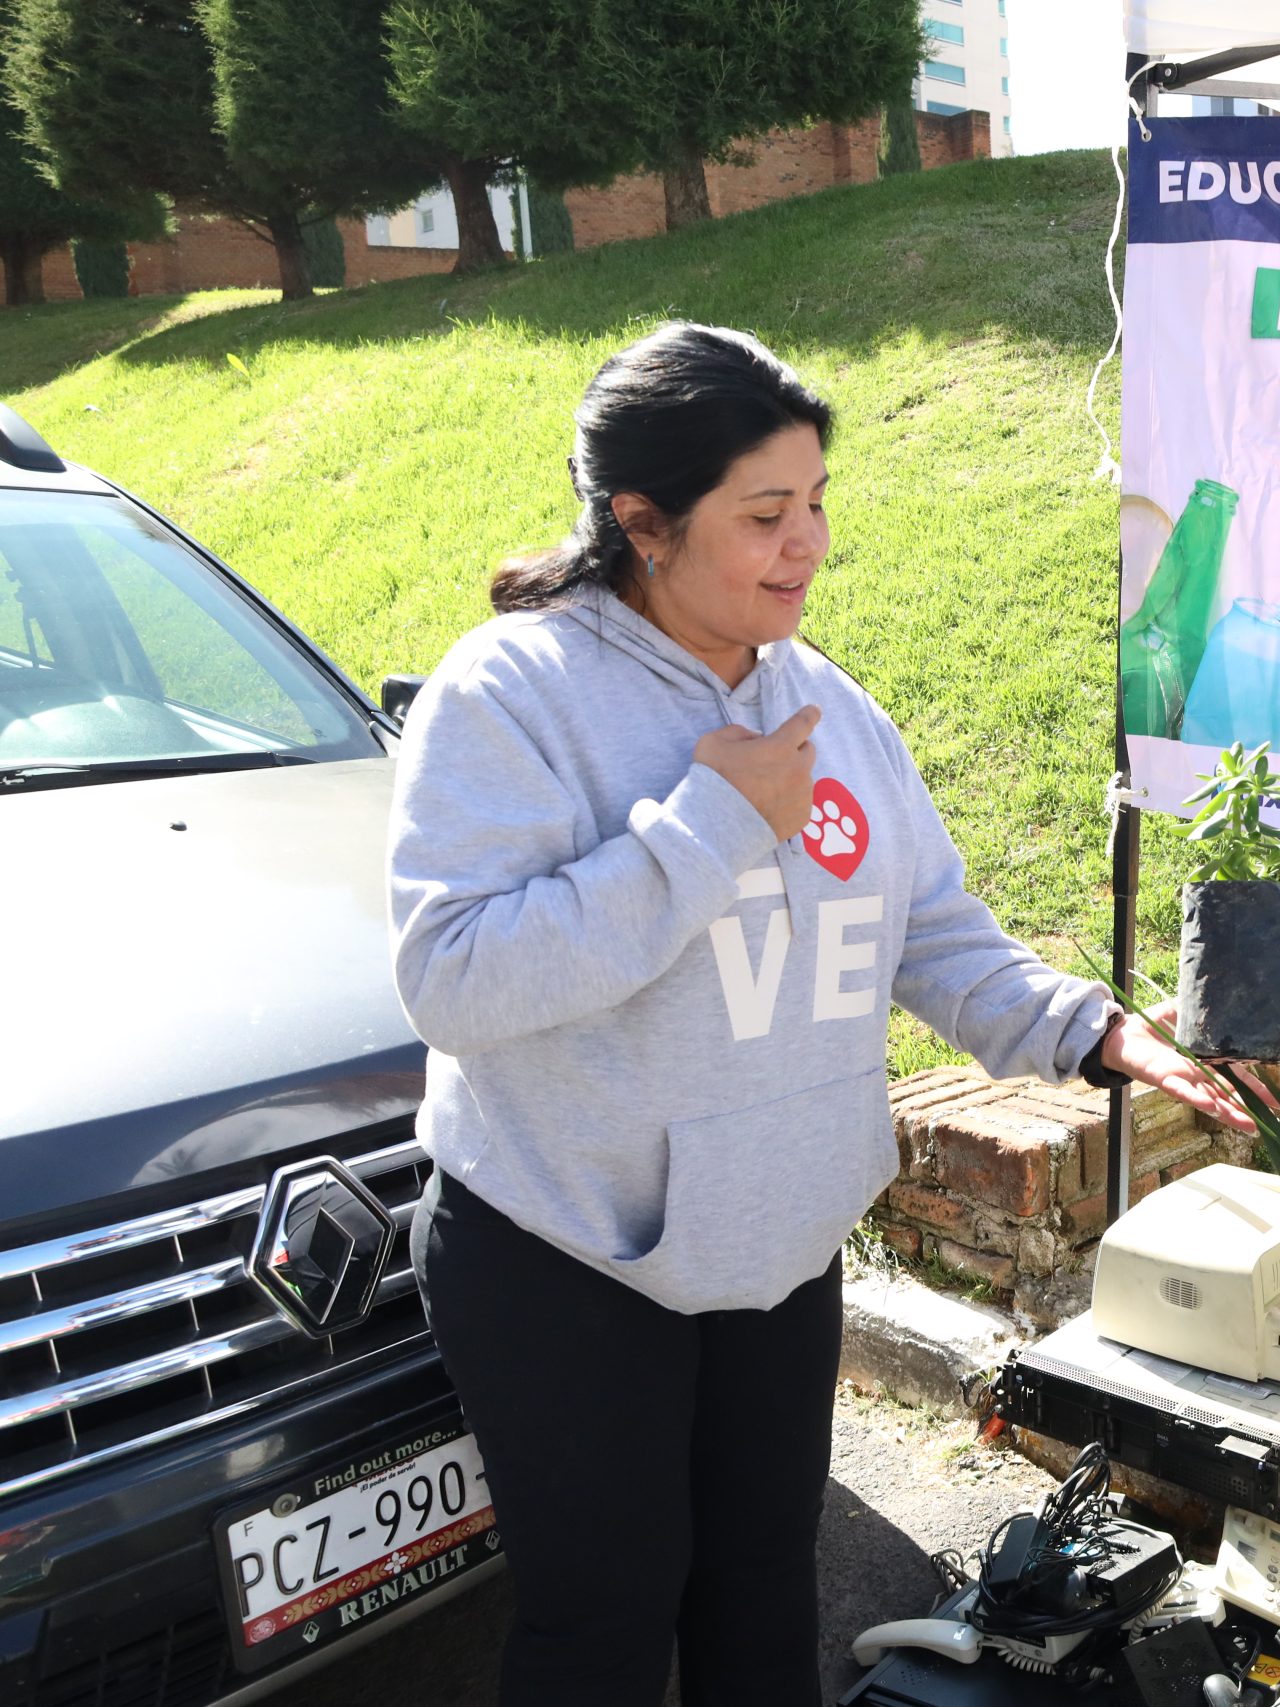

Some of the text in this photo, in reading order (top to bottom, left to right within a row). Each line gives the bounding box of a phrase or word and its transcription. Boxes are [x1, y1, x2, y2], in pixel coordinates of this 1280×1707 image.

[314, 1465, 356, 1496] Find
[360, 1452, 392, 1474] out
[244, 1521, 254, 1536] F
[338, 1544, 468, 1627] RENAULT
